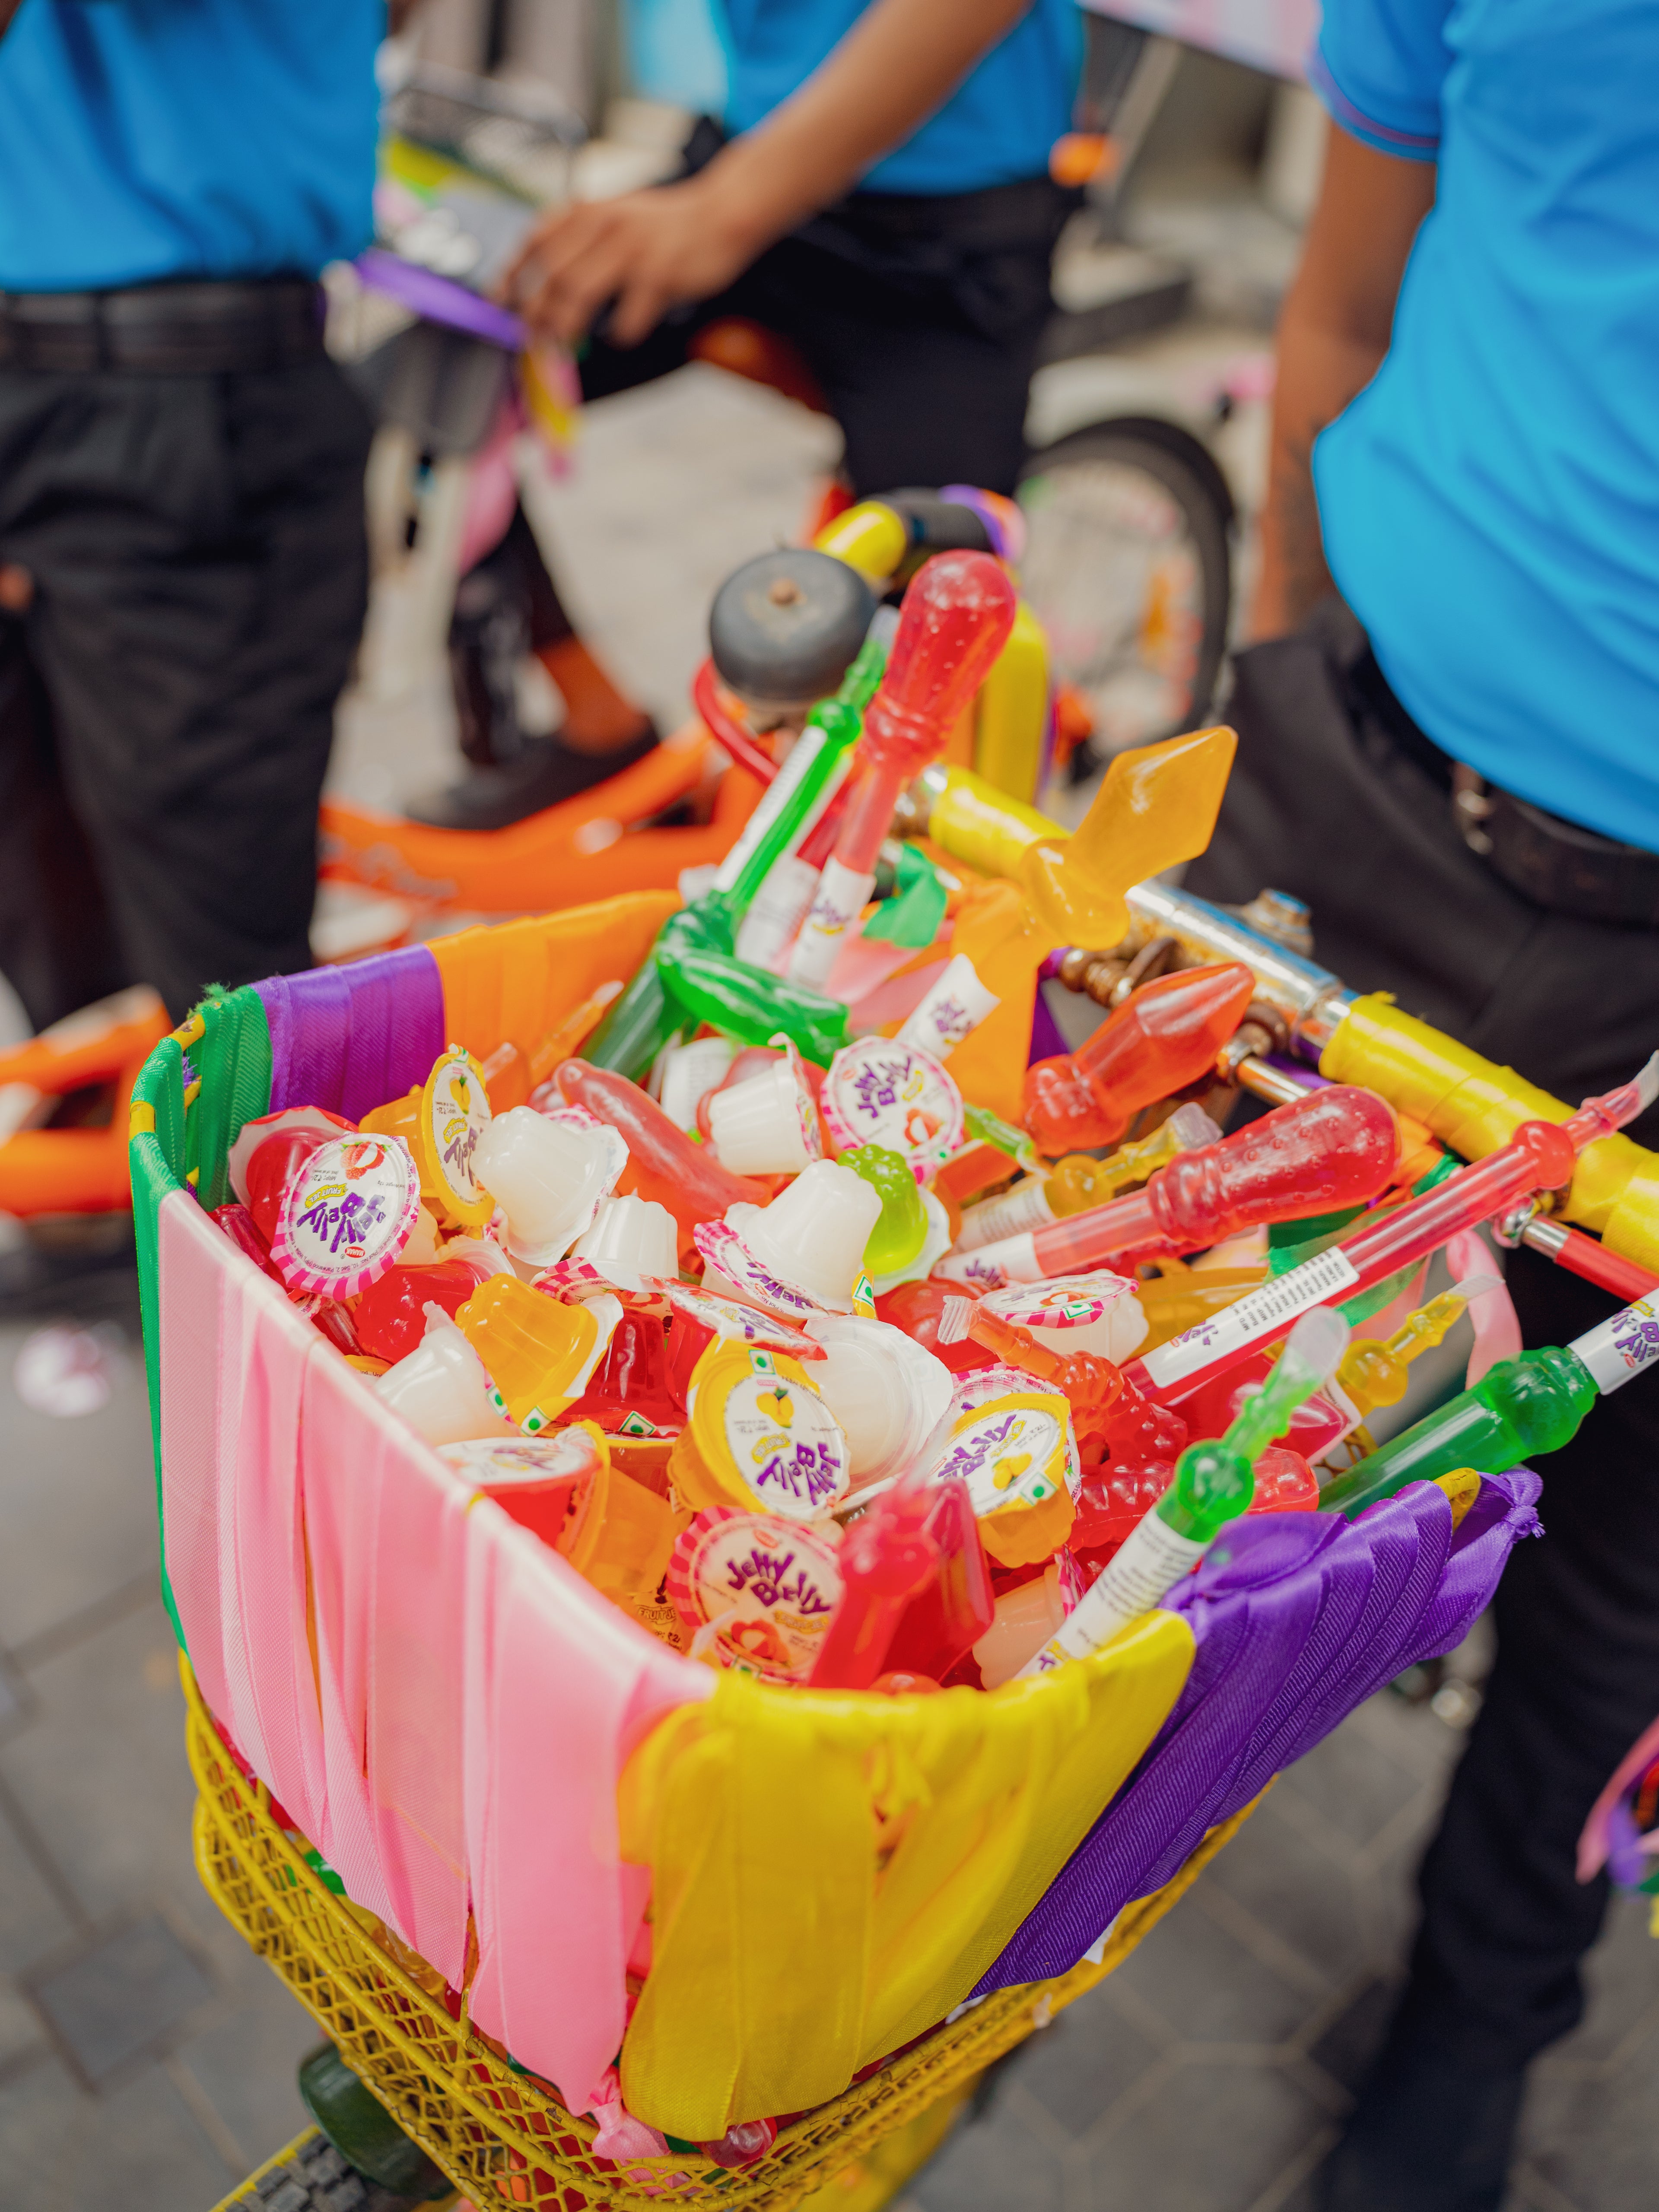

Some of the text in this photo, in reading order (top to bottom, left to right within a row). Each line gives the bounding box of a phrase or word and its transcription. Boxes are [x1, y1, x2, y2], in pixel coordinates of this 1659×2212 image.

[855, 1063, 883, 1119] Jelly
[309, 1186, 343, 1203] FRUIT JEL
[296, 1192, 366, 1241] Belly
[330, 1194, 386, 1253] Jelly
[346, 1247, 364, 1257] MAHAK
[747, 1272, 814, 1310] Jelly
[1615, 1333, 1659, 1362] elly
[962, 1414, 1017, 1477] Belly
[757, 1442, 815, 1497] Belly
[804, 1441, 841, 1506] Jelly
[727, 1549, 795, 1590] Jelly
[637, 1607, 677, 1620] FRUIT JE
[750, 1572, 832, 1615] Belly
